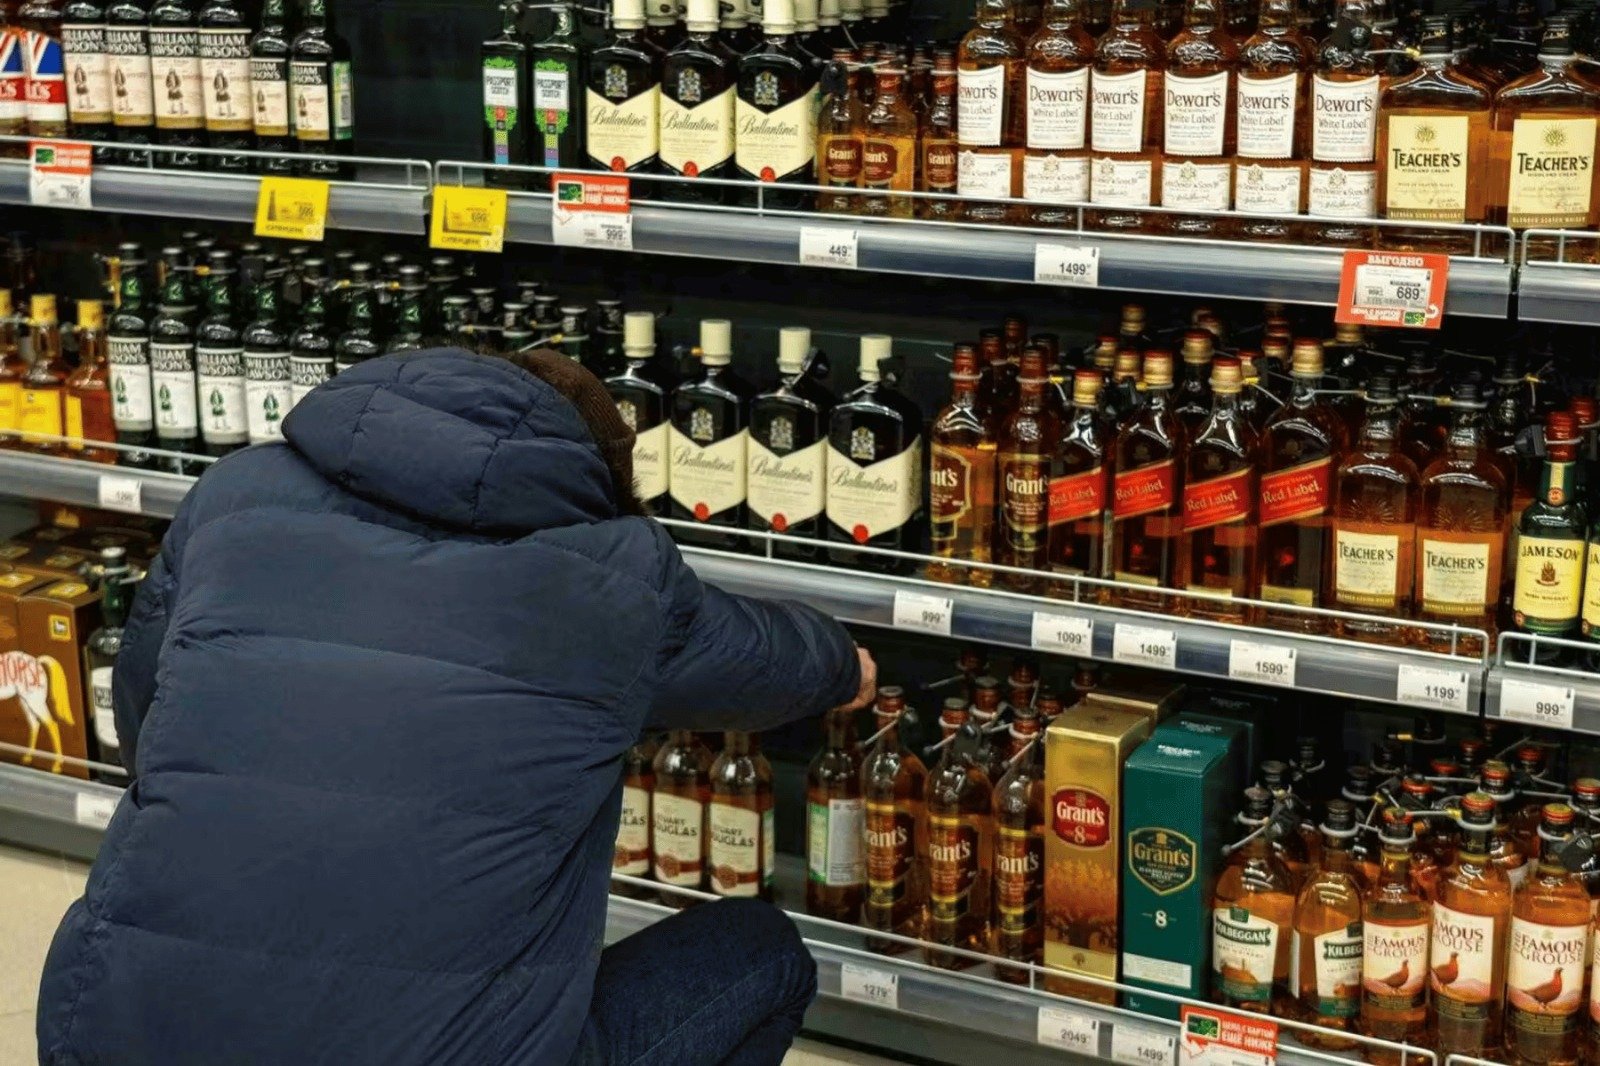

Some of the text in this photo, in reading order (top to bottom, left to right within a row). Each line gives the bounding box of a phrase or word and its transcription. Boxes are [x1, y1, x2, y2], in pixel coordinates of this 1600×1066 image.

[1030, 85, 1083, 102] Dewar's
[1167, 89, 1221, 108] Dewar's
[1239, 91, 1290, 109] Dewar's
[1316, 94, 1373, 112] Dewar's
[1392, 148, 1461, 170] TEACHER'S
[1517, 152, 1589, 174] TEACHER'S
[829, 246, 848, 257] 449
[1059, 262, 1086, 275] 1499
[1367, 254, 1425, 267] ВЫГОДНО
[1396, 286, 1421, 300] 689
[831, 465, 898, 493] Ballantine's
[1338, 541, 1394, 561] TEACHER'S
[1521, 545, 1580, 561] JAMESON
[1426, 551, 1485, 570] TEACHER'S
[921, 611, 941, 623] 999
[1056, 631, 1082, 644] 1099
[1139, 643, 1166, 656] 1499
[1255, 661, 1283, 675] 1599
[1425, 685, 1455, 700] 1199
[1536, 702, 1560, 716] 999
[1056, 801, 1105, 826] Grant's
[1074, 825, 1086, 844] 8
[1133, 842, 1190, 867] Grant's
[1155, 910, 1168, 928] 8
[1374, 935, 1425, 948] FAMOUS
[1523, 935, 1584, 953] FAMOUS
[1137, 1046, 1163, 1061] 1499
